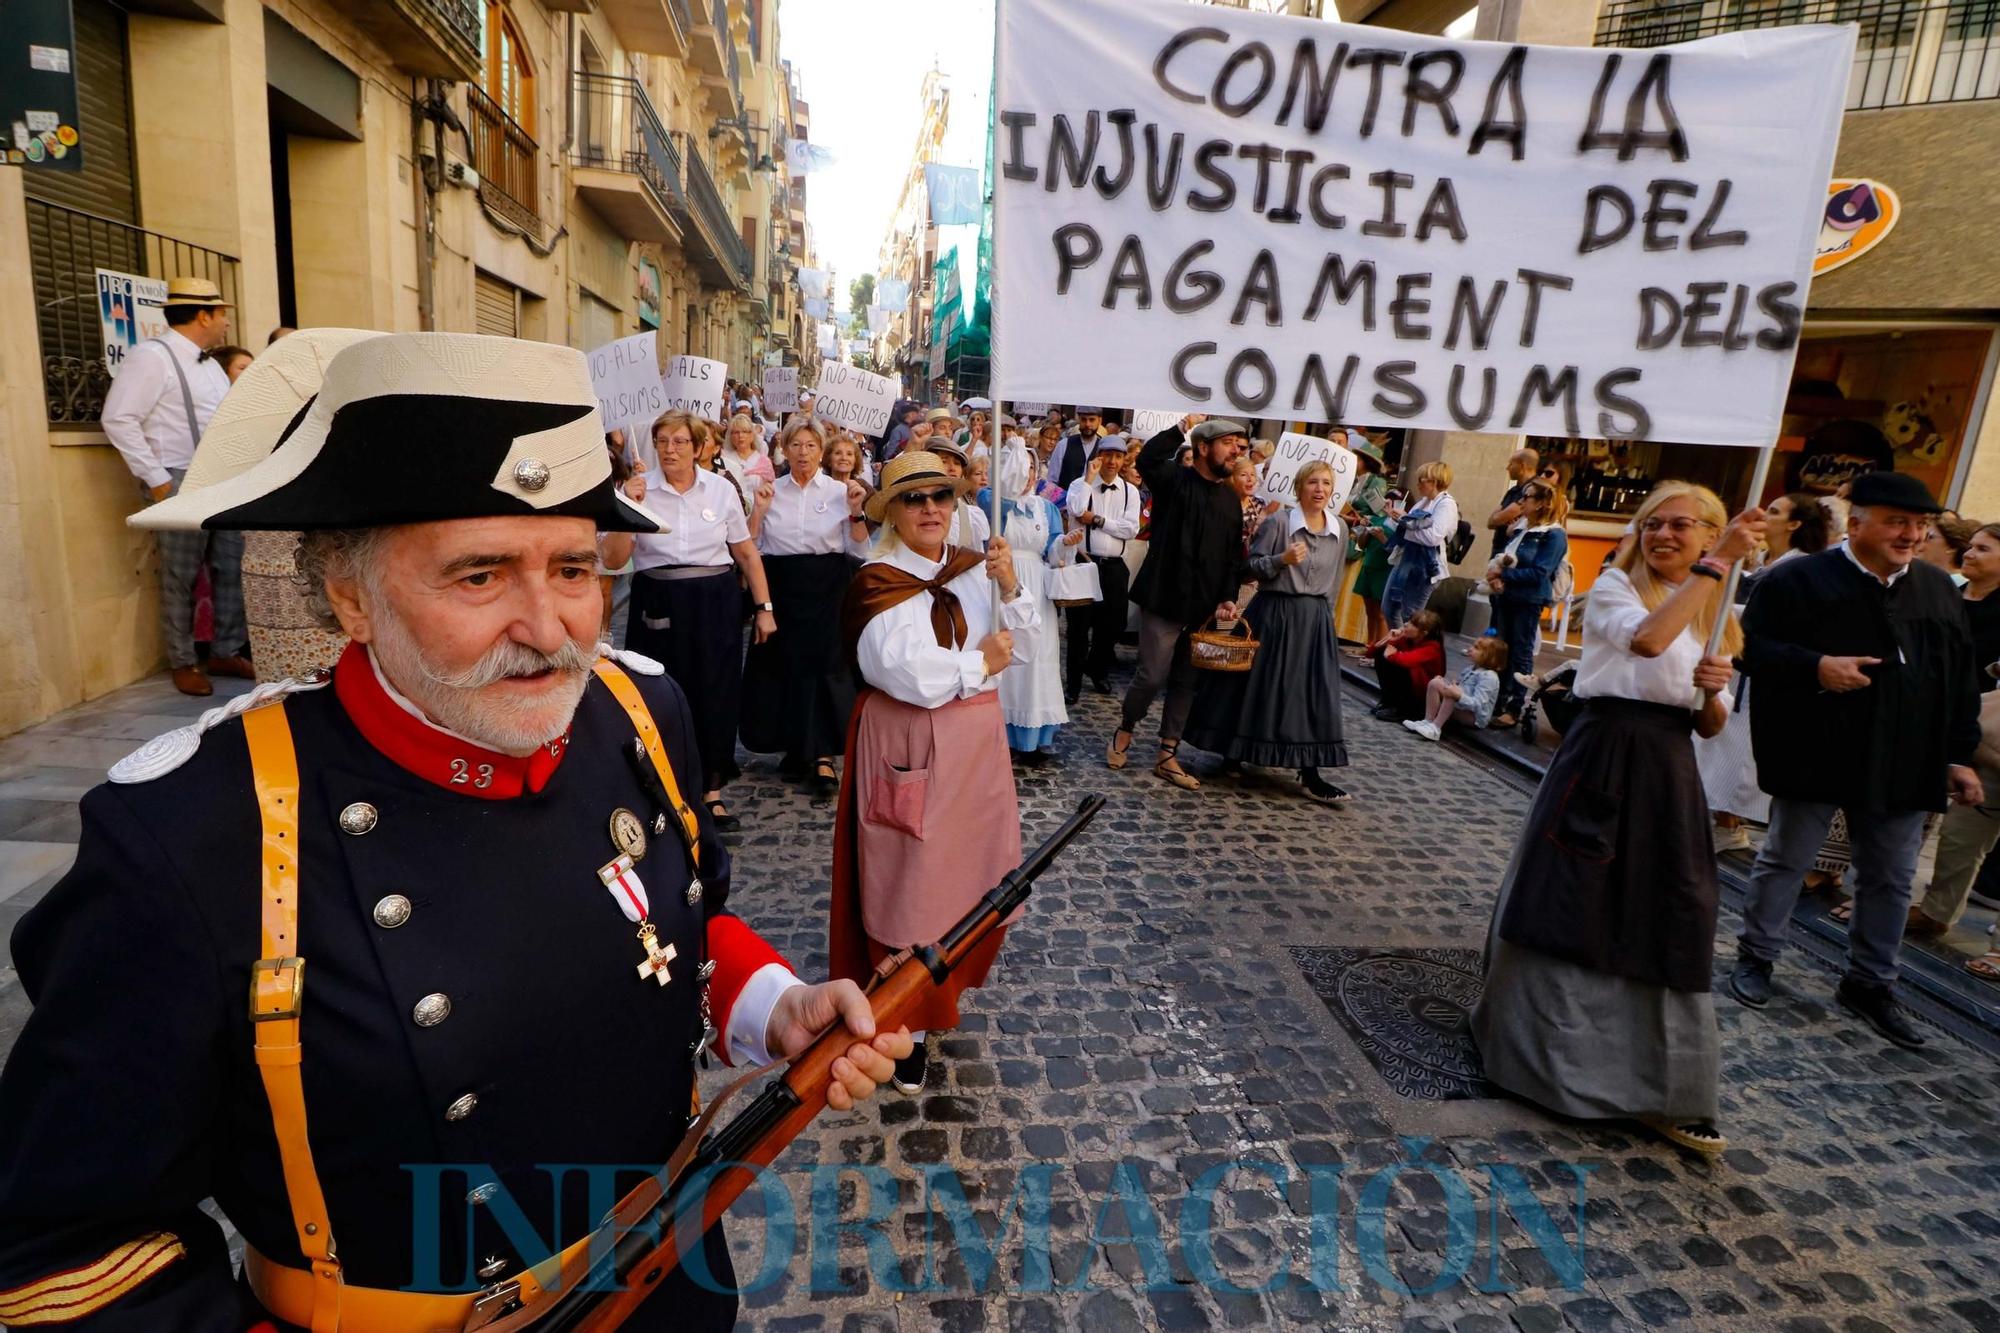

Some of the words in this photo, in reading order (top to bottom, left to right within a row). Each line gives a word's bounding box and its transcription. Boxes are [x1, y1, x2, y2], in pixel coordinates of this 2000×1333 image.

[1153, 26, 1529, 161] CONTRA
[1578, 53, 1690, 162] LA
[1001, 109, 1467, 240] INJUSTICIA
[1578, 178, 1750, 254] DEL
[1052, 222, 1574, 350] PAGAMENT
[1636, 280, 1800, 351] DELS
[815, 395, 889, 430] CONSUMS
[825, 365, 887, 396] NO-ALS
[1169, 341, 1651, 440] CONSUMS
[450, 758, 494, 788] 23
